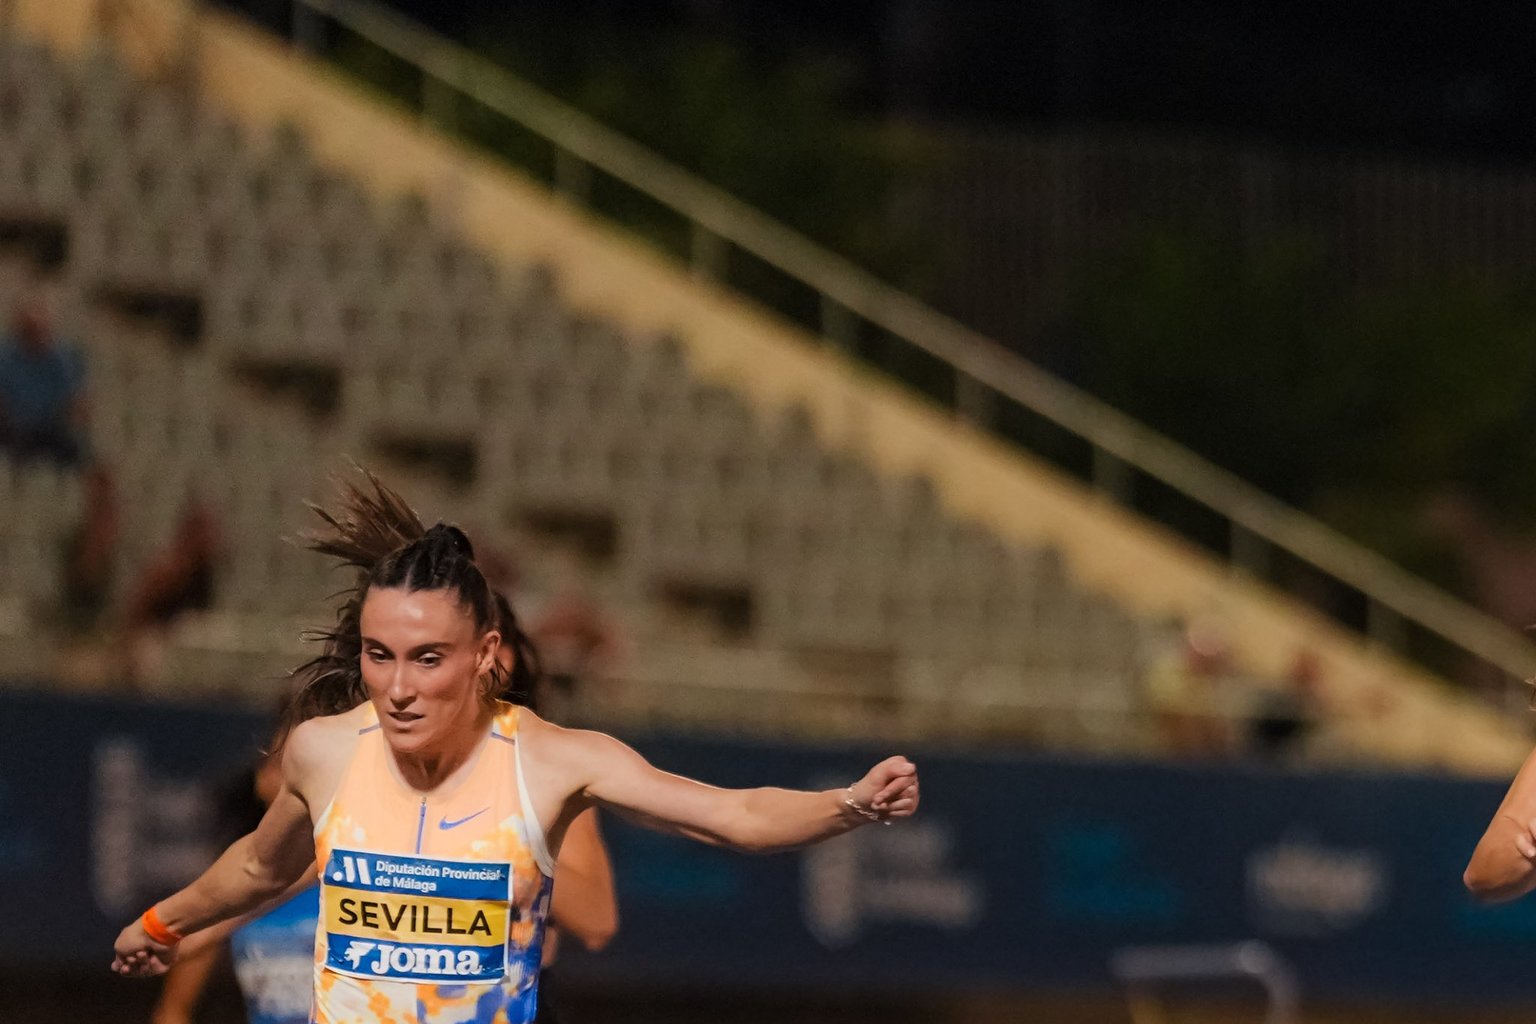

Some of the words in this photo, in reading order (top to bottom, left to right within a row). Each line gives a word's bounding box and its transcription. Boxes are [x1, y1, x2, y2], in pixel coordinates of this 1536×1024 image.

[375, 860, 440, 878] Diputación
[441, 866, 501, 881] Provincial
[374, 875, 390, 887] de
[392, 877, 437, 893] Málaga
[338, 898, 492, 936] SEVILLA
